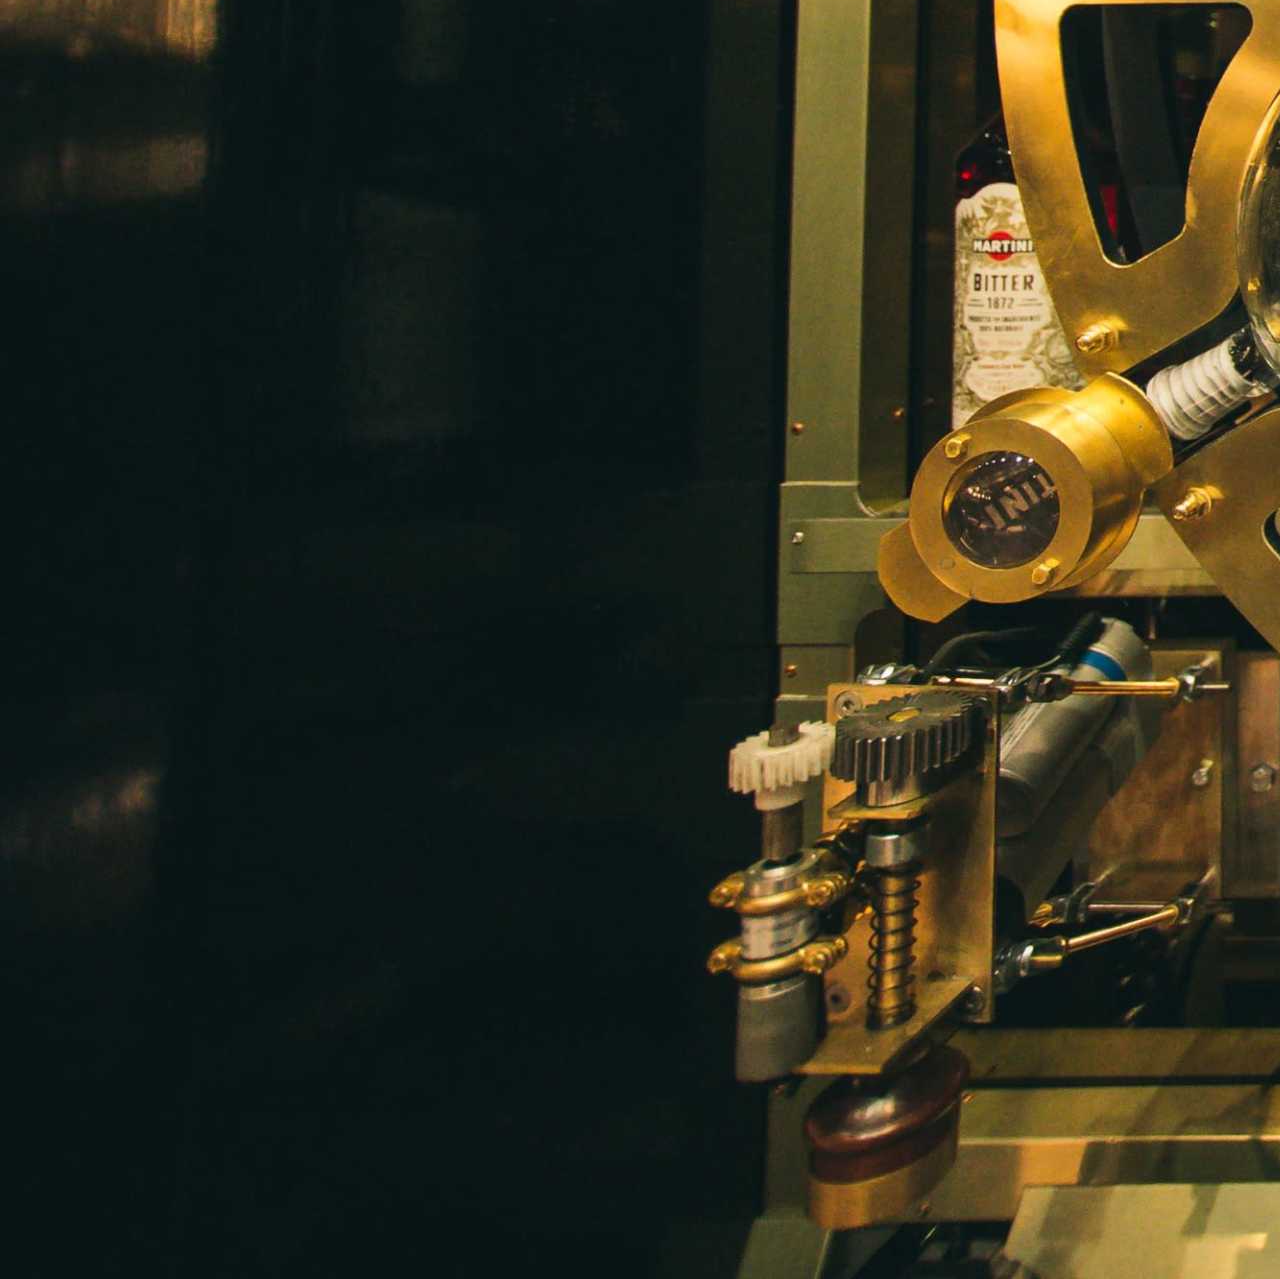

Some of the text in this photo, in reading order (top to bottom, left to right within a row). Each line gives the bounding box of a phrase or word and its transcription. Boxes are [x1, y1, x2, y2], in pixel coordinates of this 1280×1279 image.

[973, 239, 1033, 253] MARTINI
[974, 273, 1034, 292] BITTER
[987, 296, 1015, 310] 1872
